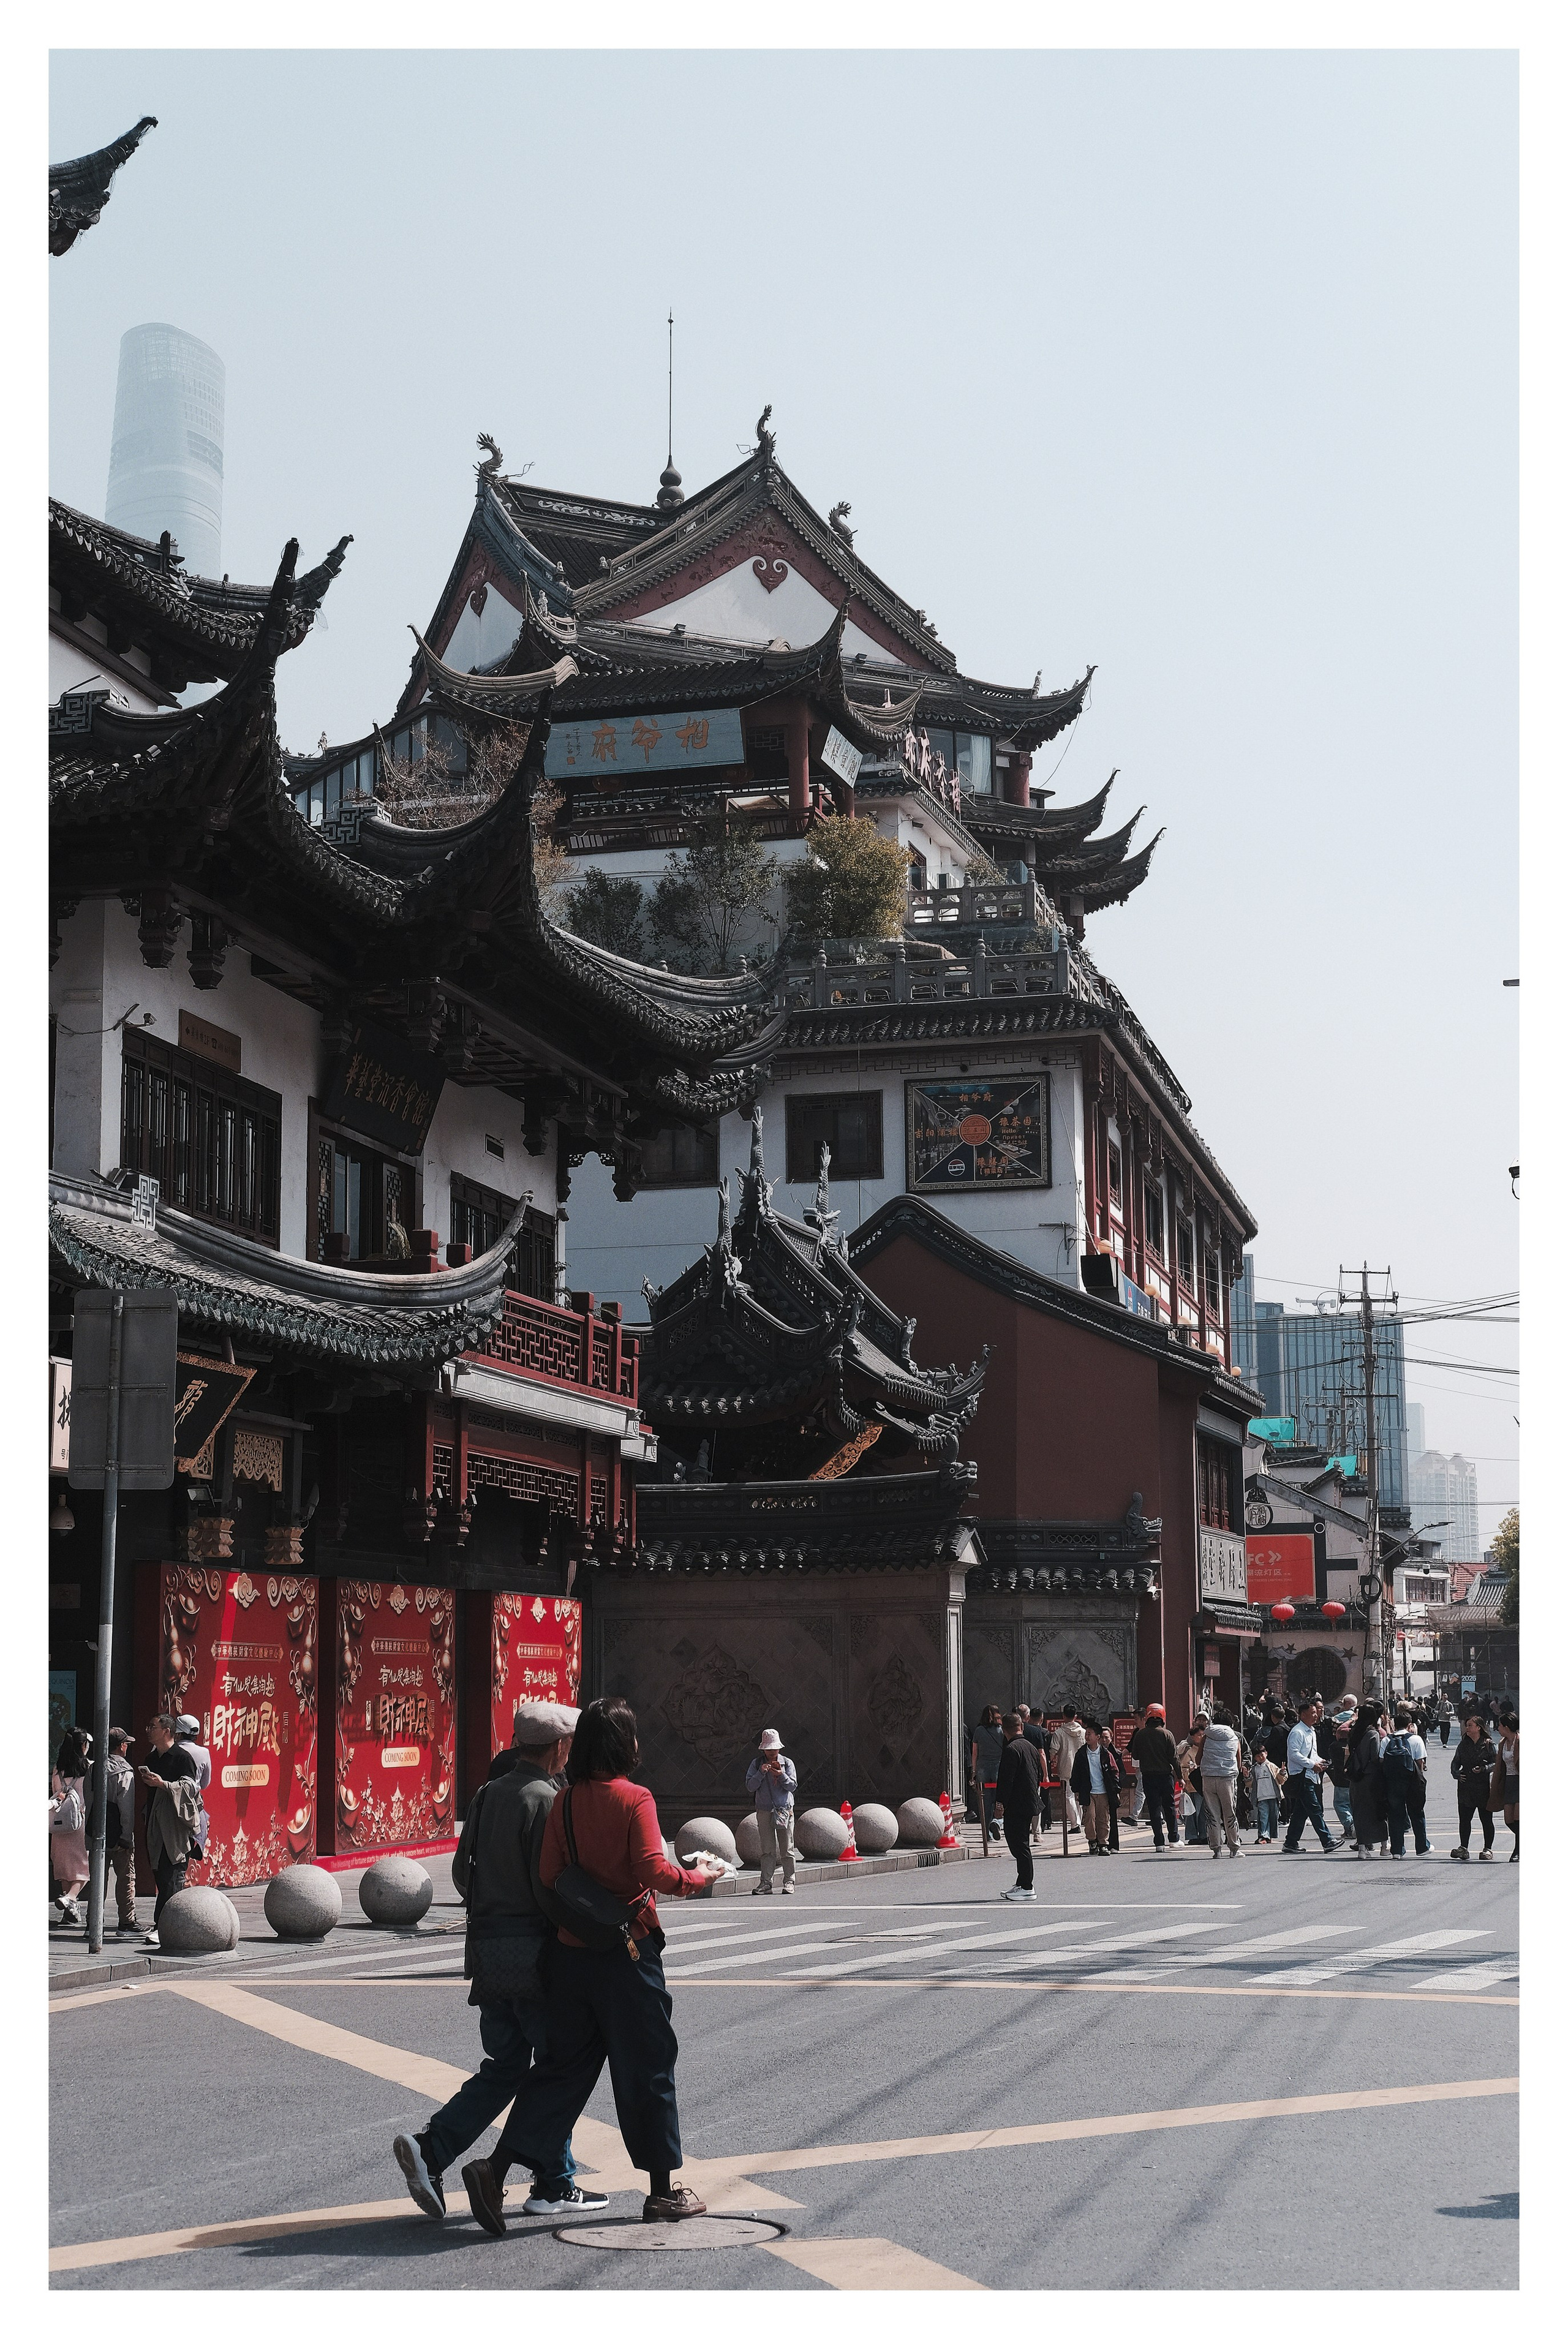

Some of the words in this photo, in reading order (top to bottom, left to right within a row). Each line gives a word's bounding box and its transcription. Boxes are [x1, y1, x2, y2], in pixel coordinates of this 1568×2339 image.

[1247, 1553, 1264, 1565] FC
[213, 1701, 281, 1758] 財神殿
[385, 1753, 404, 1763] COMING
[404, 1752, 417, 1761] SOON
[225, 1771, 249, 1782] COMING
[249, 1770, 265, 1781] SOON
[337, 1859, 350, 1868] blessing
